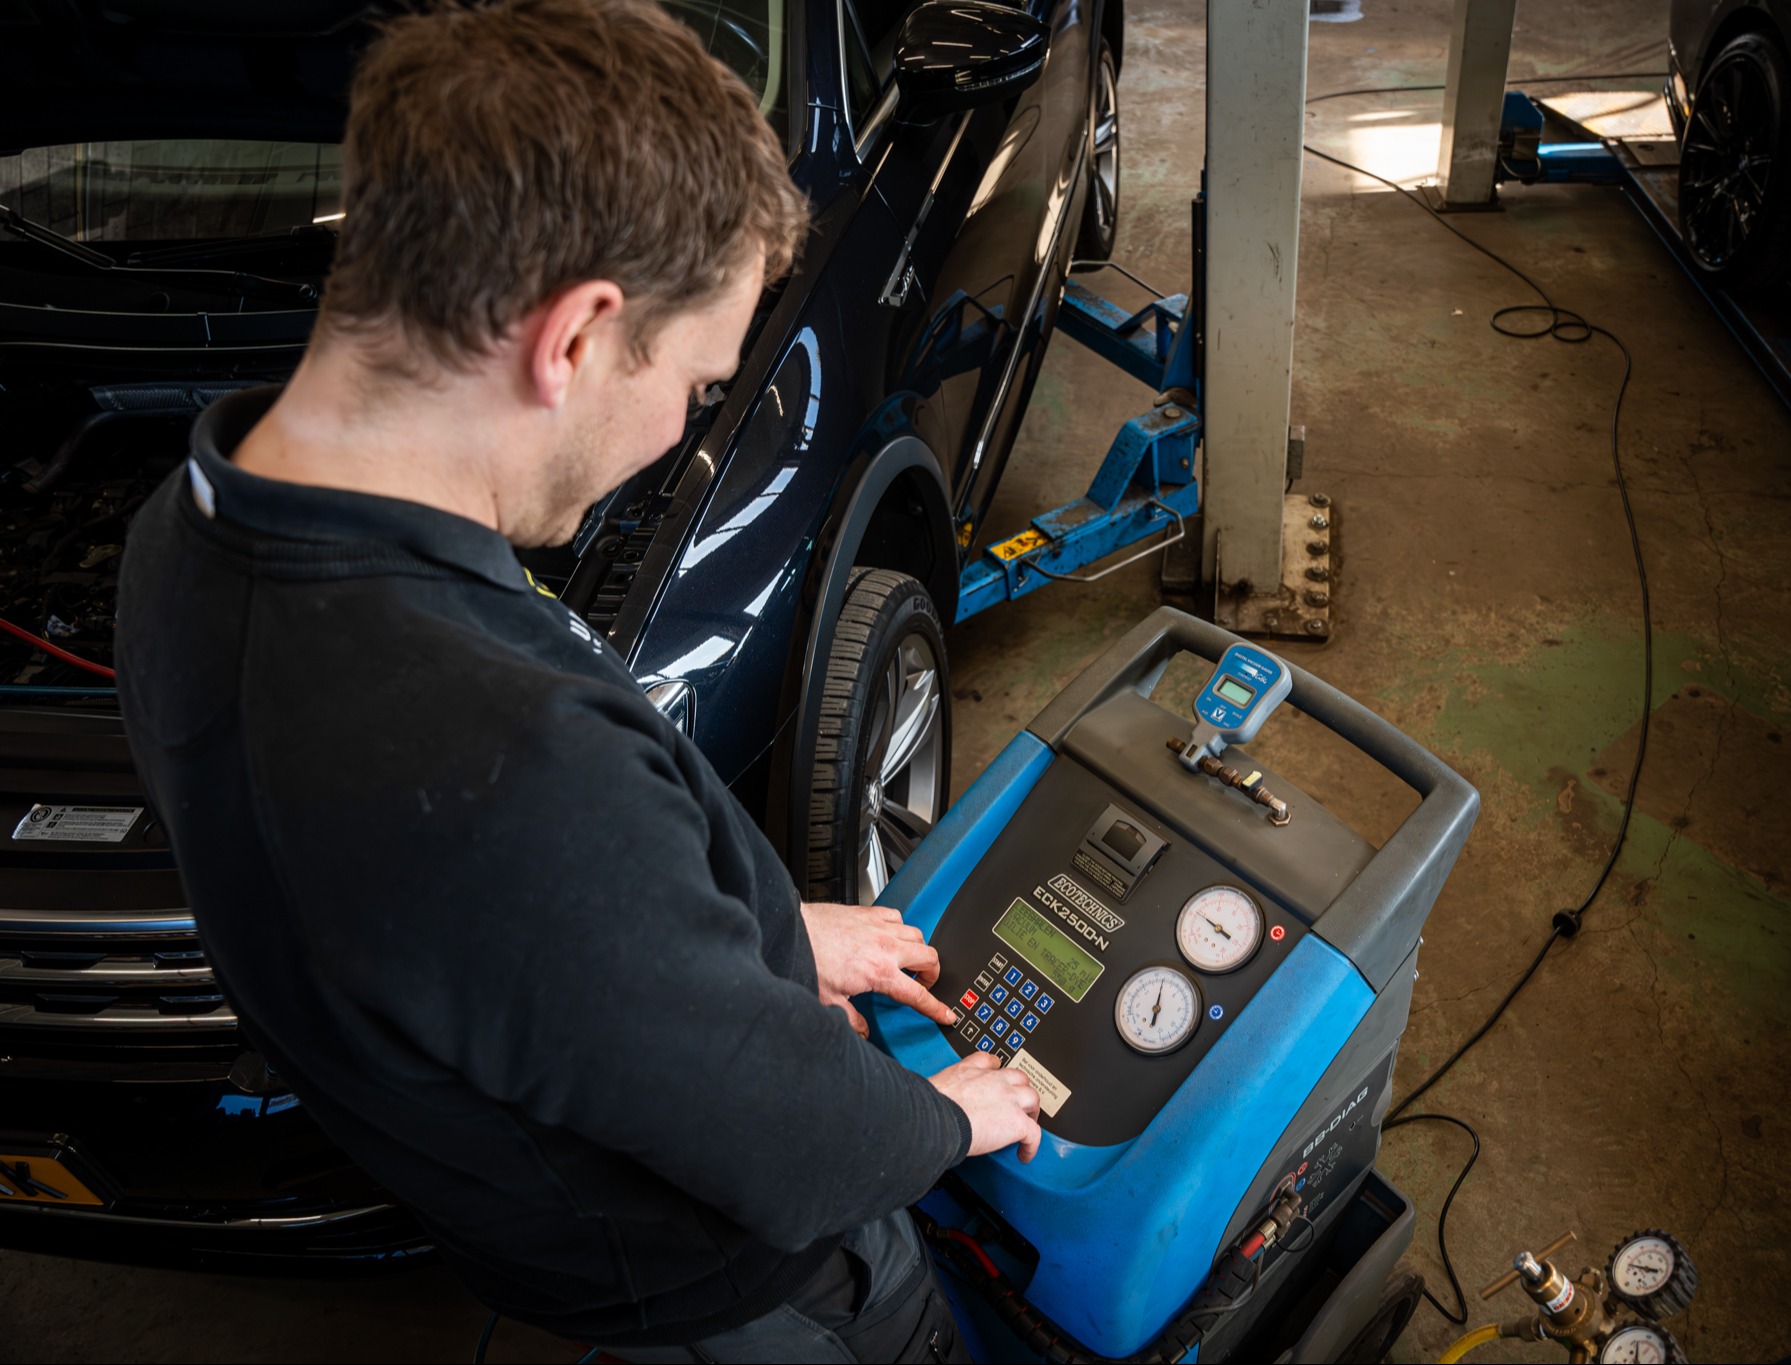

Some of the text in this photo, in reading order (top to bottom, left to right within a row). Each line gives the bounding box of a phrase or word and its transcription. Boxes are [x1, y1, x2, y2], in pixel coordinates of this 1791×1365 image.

[1053, 877, 1119, 929] ECOTECHNICS
[1033, 885, 1110, 951] ECK2500-N
[1027, 937, 1039, 950] EN
[991, 956, 1005, 969] START
[1067, 957, 1079, 970] 25
[963, 994, 975, 1005] STOP
[1303, 1086, 1369, 1159] BB-DIAG
